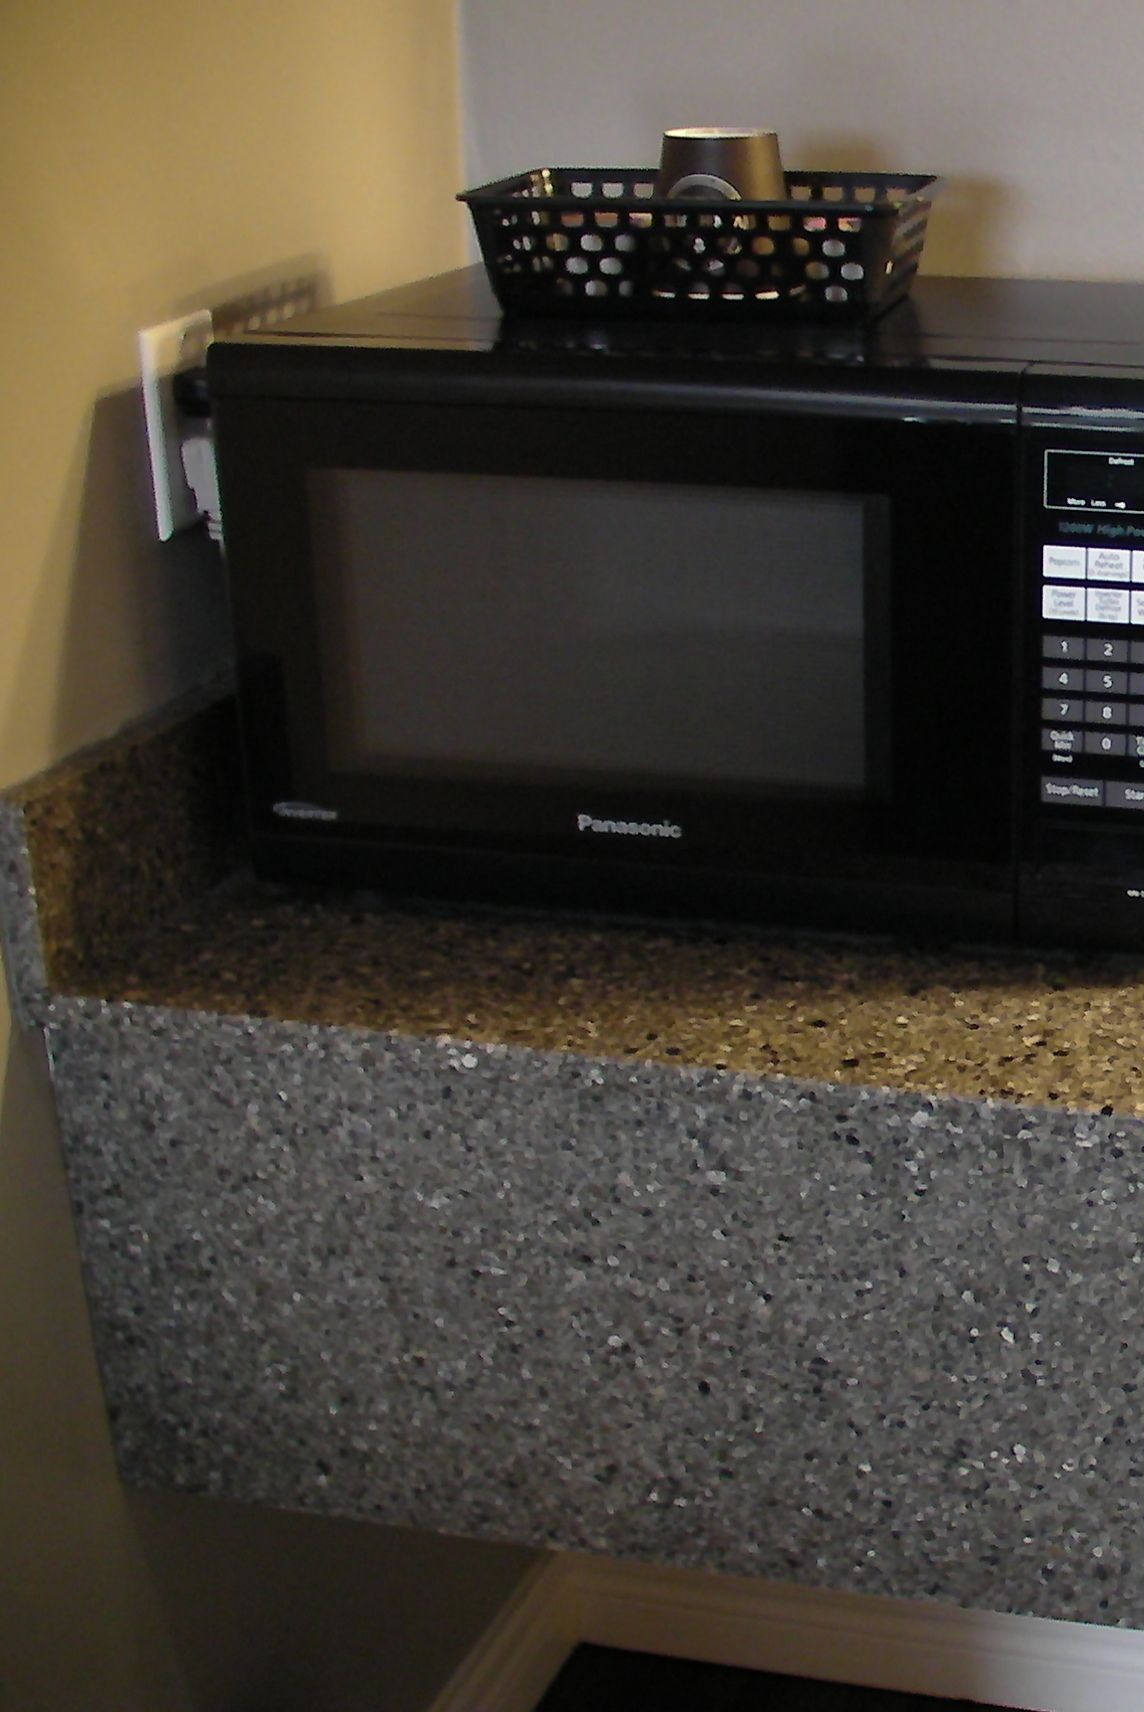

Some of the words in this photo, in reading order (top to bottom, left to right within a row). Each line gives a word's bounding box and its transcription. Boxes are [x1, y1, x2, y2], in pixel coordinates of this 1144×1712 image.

[1060, 640, 1068, 653] 1
[1103, 643, 1113, 656] 2
[1058, 672, 1068, 685] 4
[1103, 675, 1112, 688] 5
[1060, 703, 1069, 715] 7
[1102, 706, 1112, 719] 8
[1101, 737, 1111, 750] 0
[577, 814, 682, 839] Panasonic
